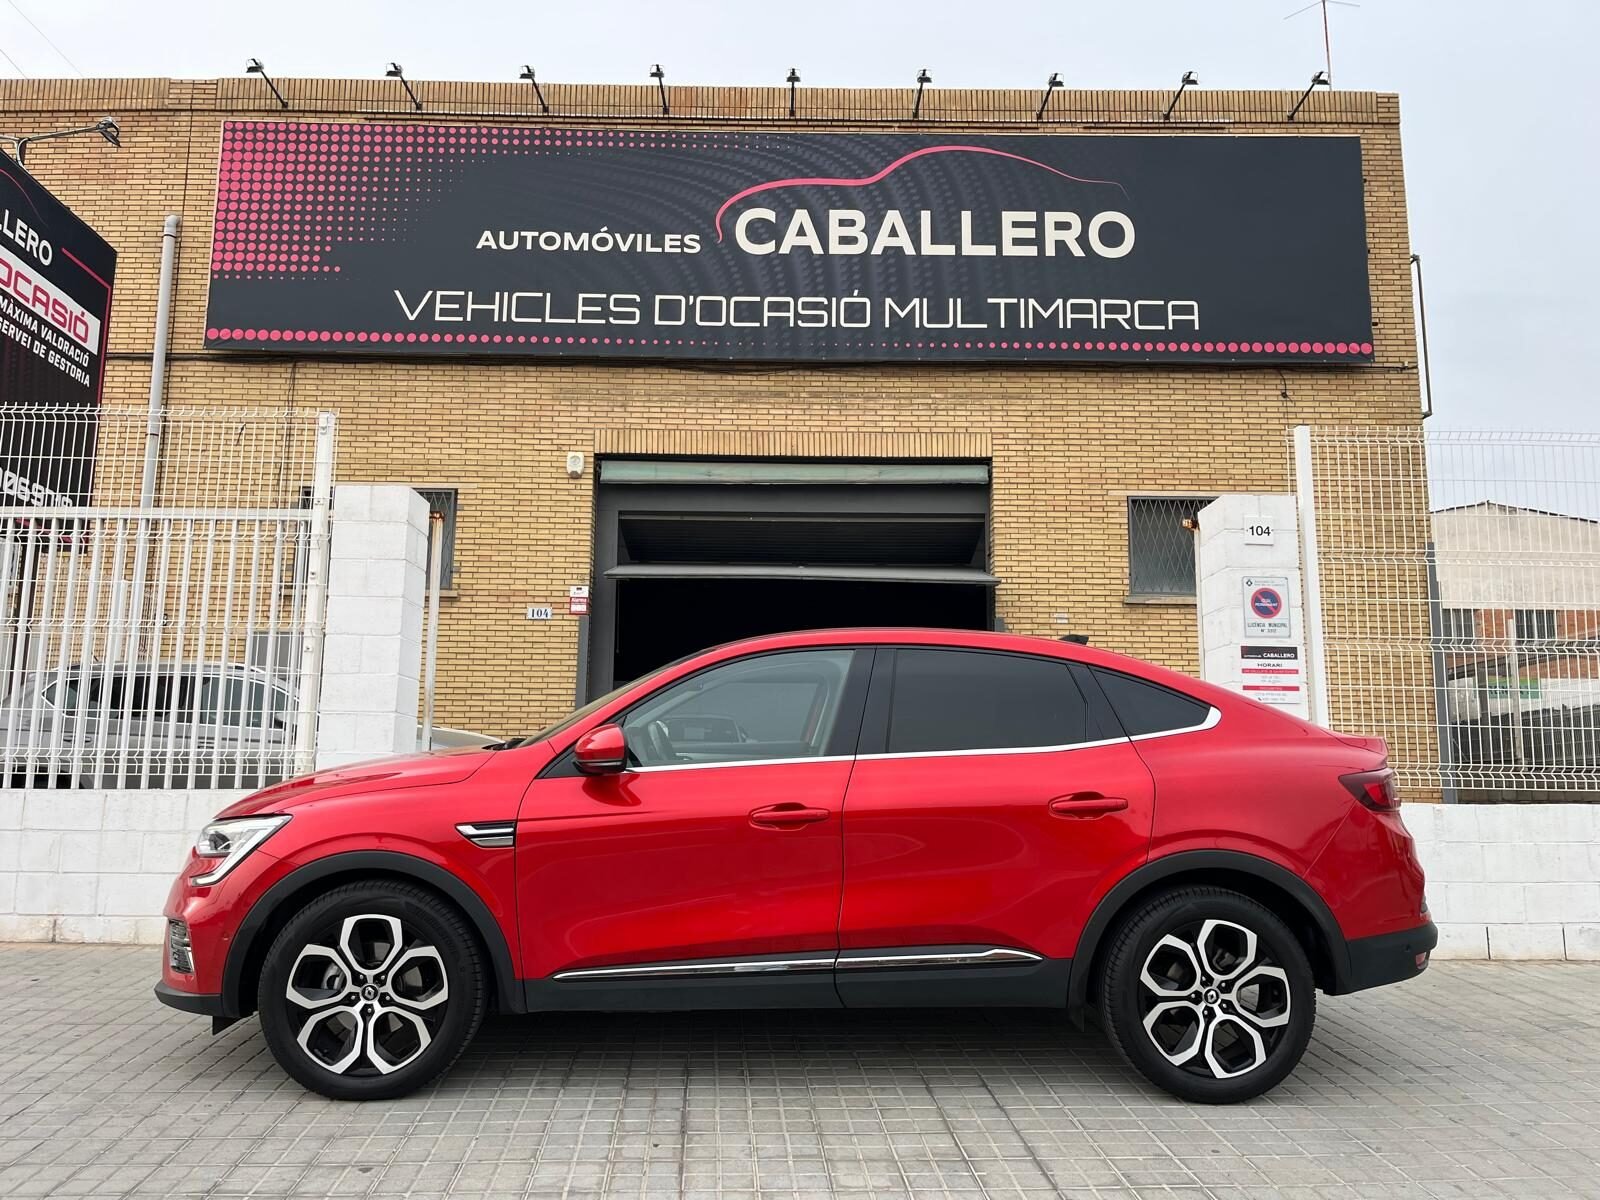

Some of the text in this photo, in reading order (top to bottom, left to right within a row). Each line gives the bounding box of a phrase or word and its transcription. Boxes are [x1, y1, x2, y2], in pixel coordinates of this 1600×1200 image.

[0, 208, 53, 266] LERO
[476, 207, 1136, 259] AUTOMÓVILES CABALLERO
[394, 289, 1200, 331] VEHICLES D'OCASIÓ MULTIMARCA
[33, 340, 47, 359] DE
[48, 350, 90, 388] GESTORIA
[41, 324, 89, 368] VALORACIÓ
[1249, 525, 1271, 537] 104
[531, 608, 549, 618] 104
